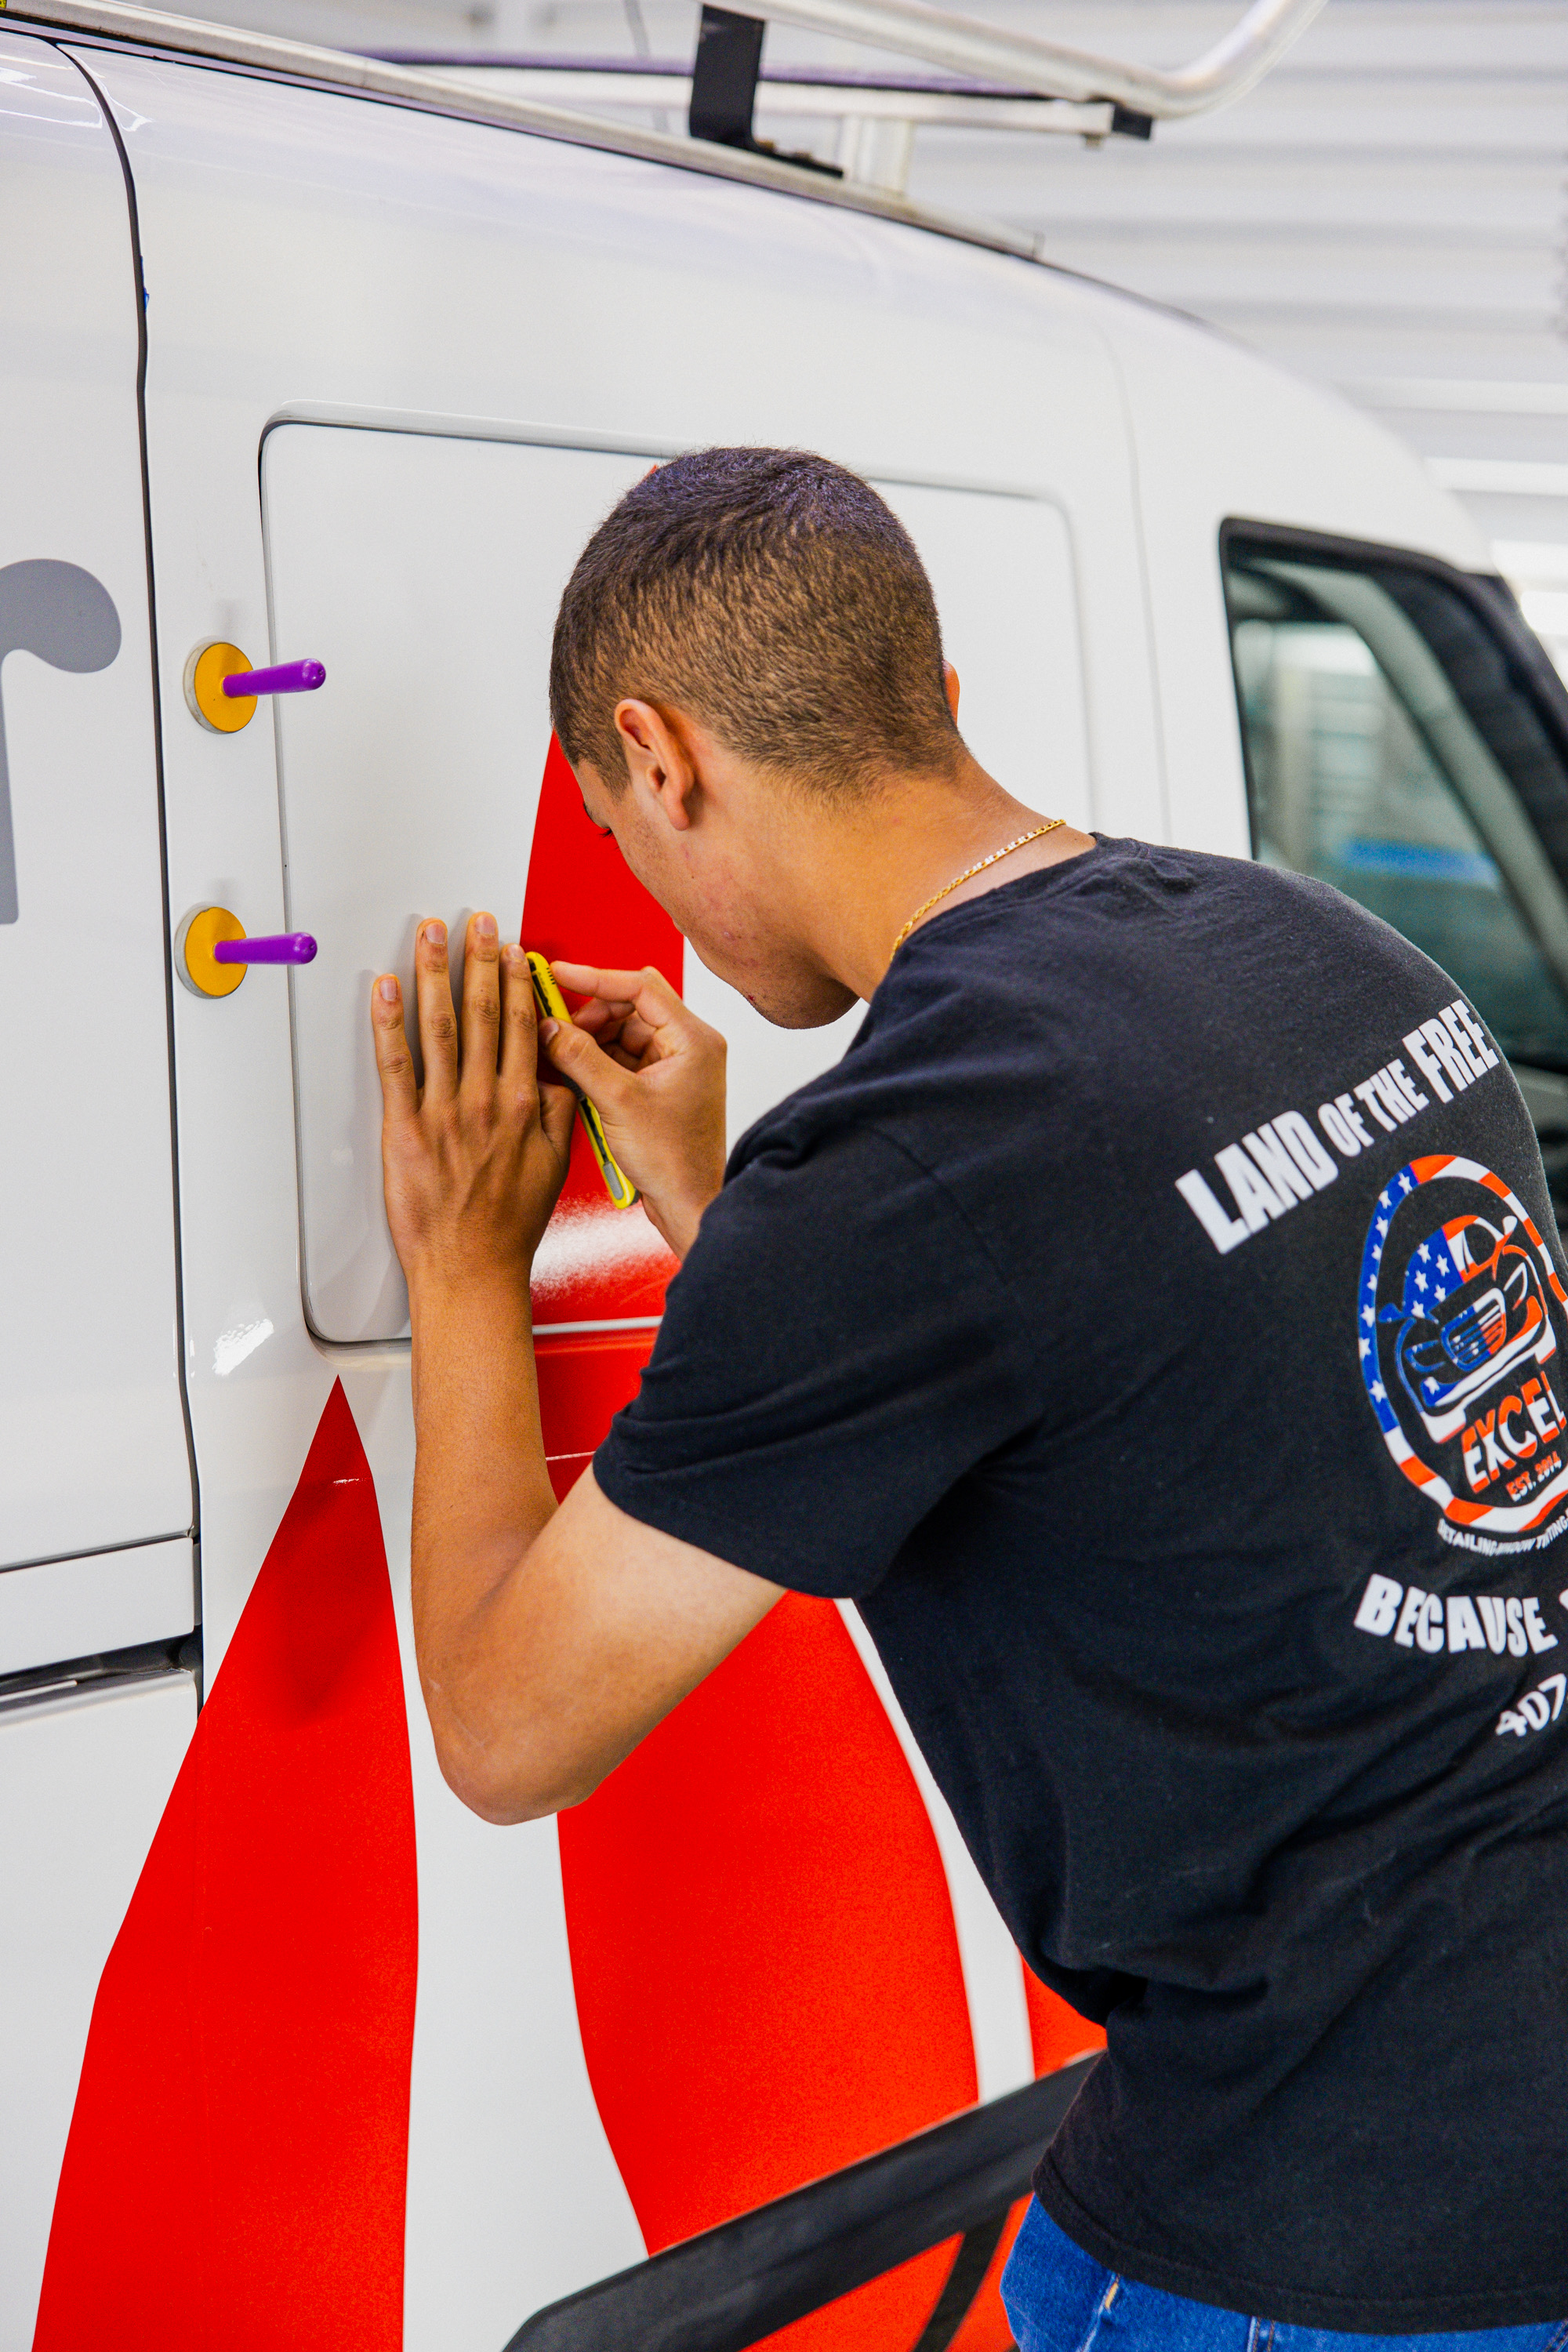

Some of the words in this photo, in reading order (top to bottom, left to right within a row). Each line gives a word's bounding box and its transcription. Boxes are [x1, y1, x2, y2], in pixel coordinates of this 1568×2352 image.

[1175, 1110, 1338, 1254] LAND
[1318, 1093, 1374, 1156] OF
[1354, 1059, 1429, 1132] THE
[1402, 1000, 1499, 1103] FREE
[1461, 1370, 1566, 1494] EXCEL
[1505, 1471, 1537, 1502] EST.
[1354, 1573, 1559, 1657] BECAUSE
[1495, 1673, 1566, 1737] 407
